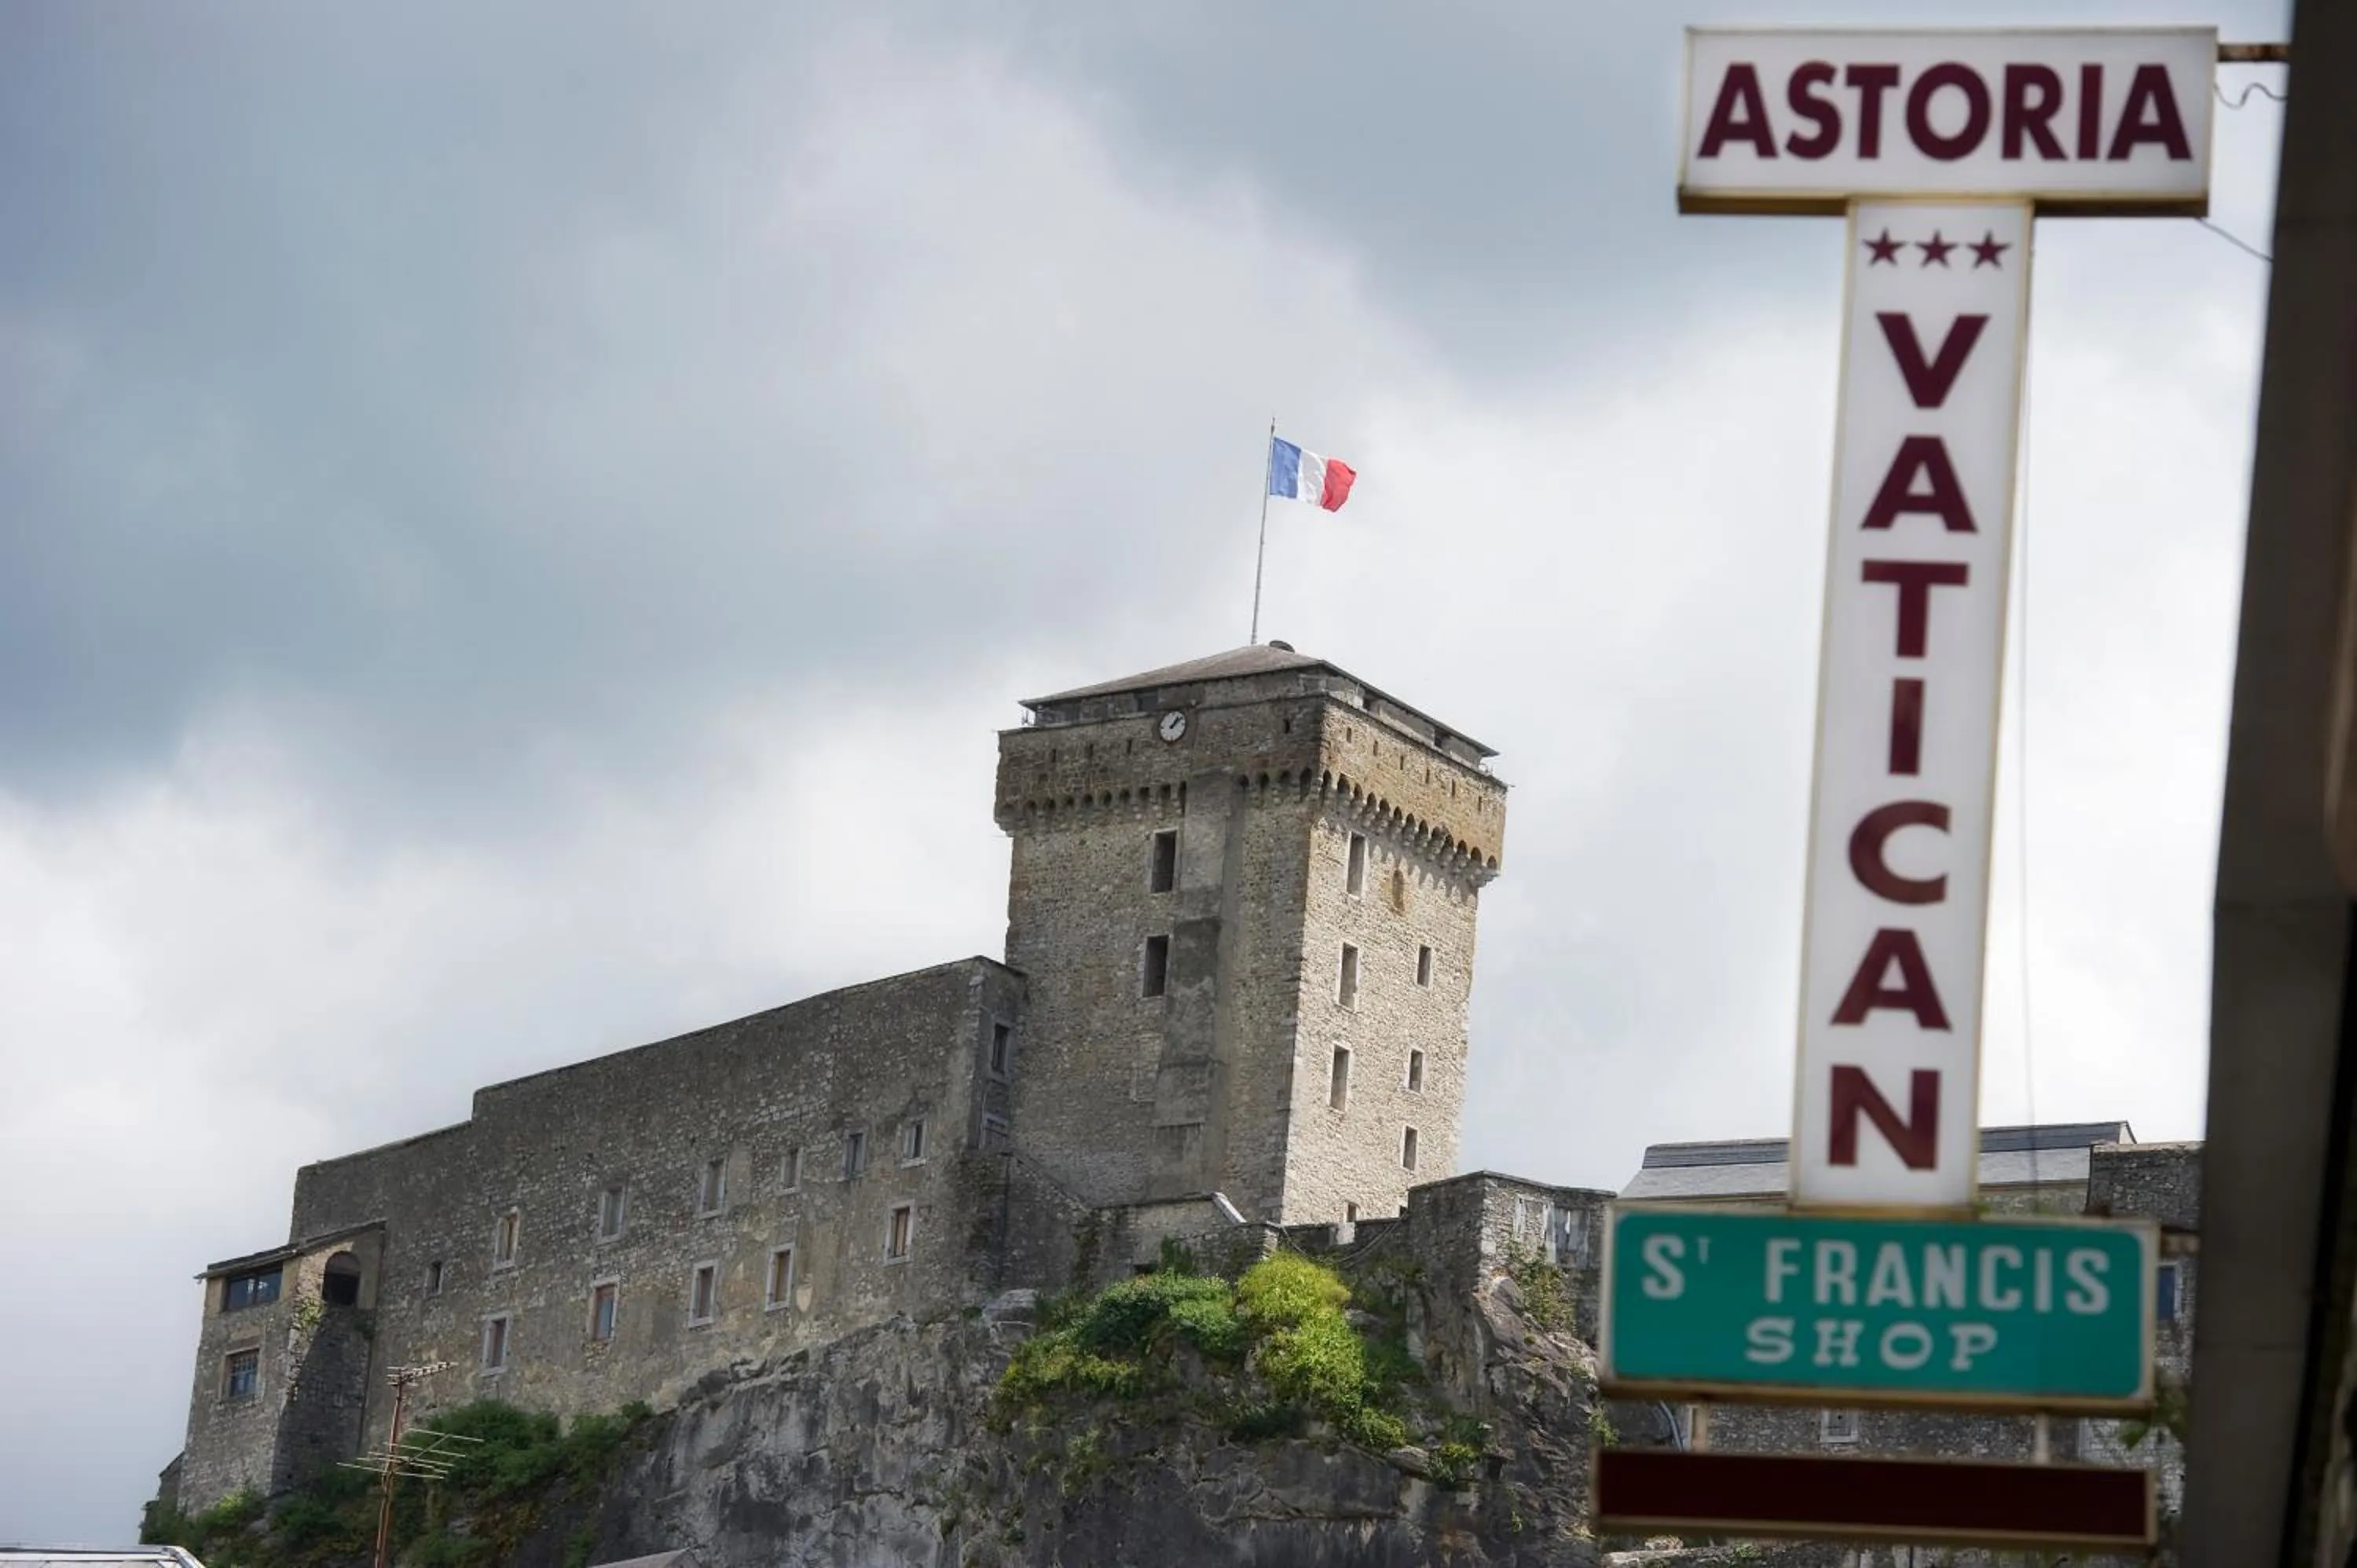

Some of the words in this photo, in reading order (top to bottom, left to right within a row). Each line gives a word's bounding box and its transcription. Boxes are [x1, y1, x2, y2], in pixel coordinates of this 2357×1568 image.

[1697, 61, 2193, 161] ASTORIA
[1828, 312, 1991, 1171] VATICAN
[1765, 1238, 2110, 1314] FRANCIS
[1746, 1317, 1998, 1370] SHOP
